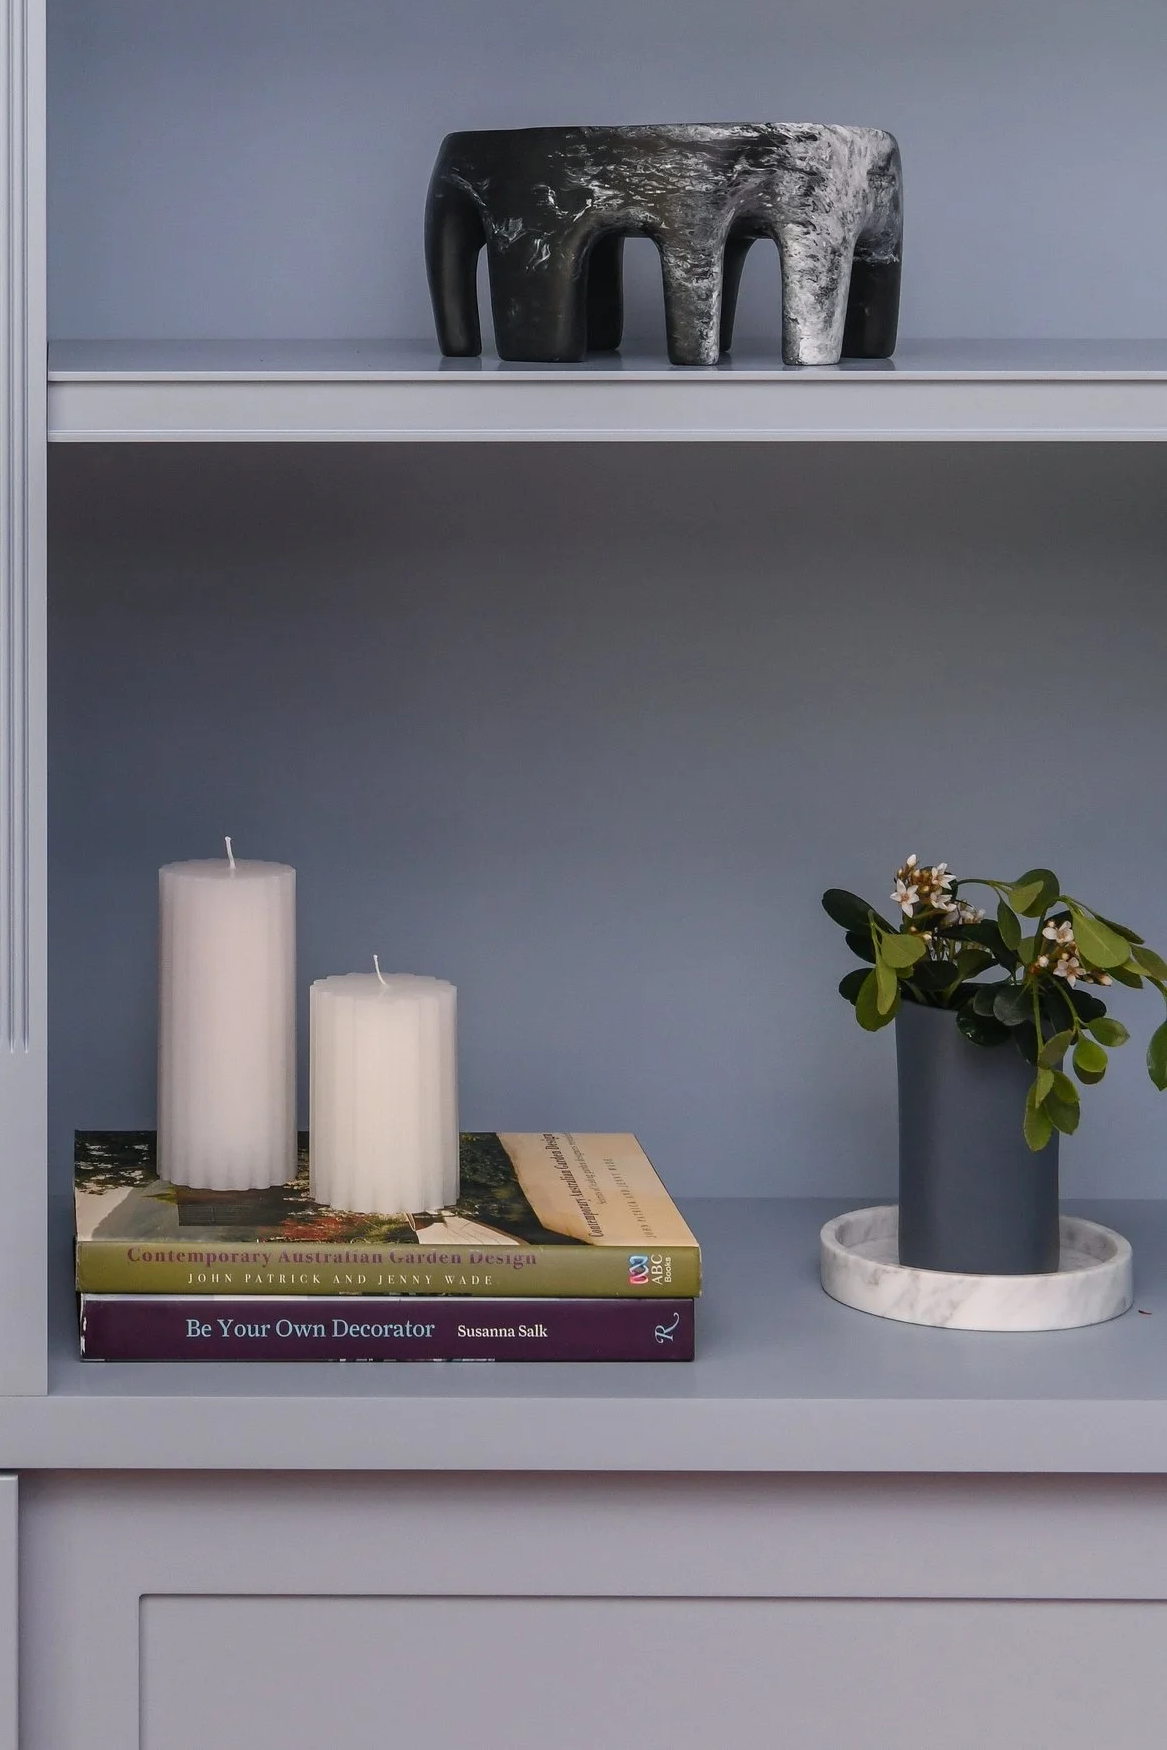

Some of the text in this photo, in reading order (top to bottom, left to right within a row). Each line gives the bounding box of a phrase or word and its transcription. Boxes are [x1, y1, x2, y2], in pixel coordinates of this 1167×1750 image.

[127, 1248, 538, 1269] Contemporary Australian Garden Design
[188, 1273, 492, 1285] JOHN PATRICK AND JENNY WADE
[650, 1253, 663, 1285] ABC
[185, 1319, 548, 1338] Be Your Own Decorator Susanna Salk
